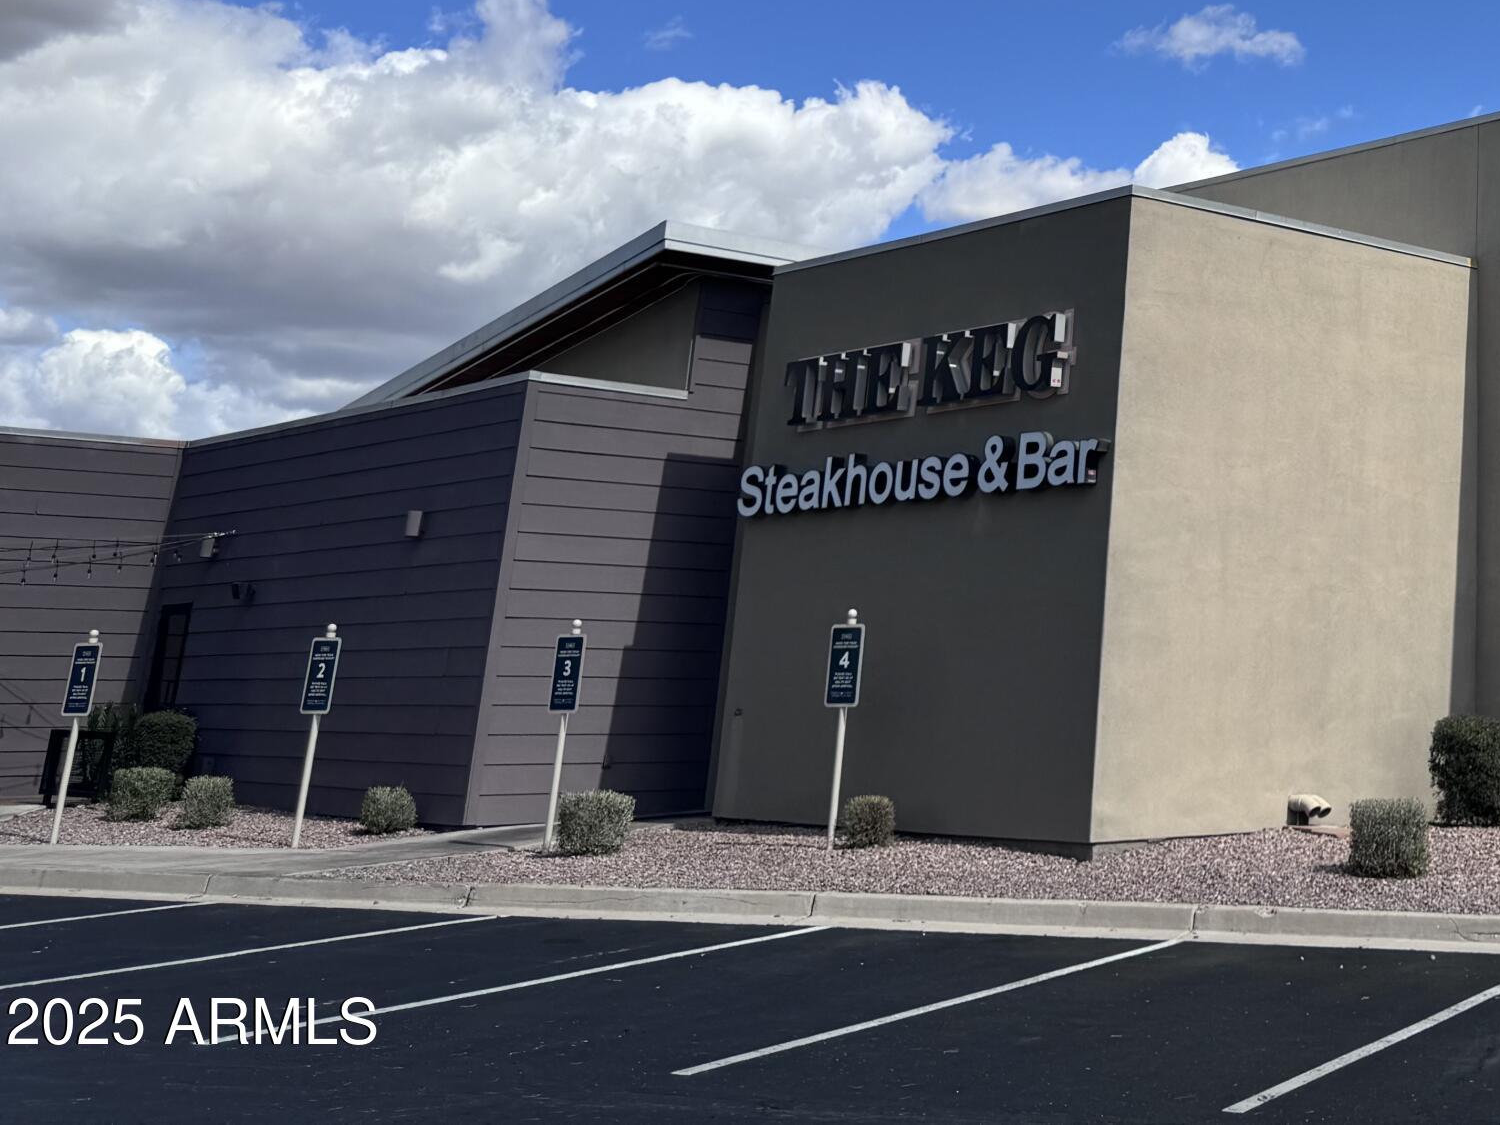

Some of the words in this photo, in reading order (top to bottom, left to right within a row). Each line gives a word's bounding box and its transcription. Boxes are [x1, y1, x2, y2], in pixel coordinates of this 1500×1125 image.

[784, 341, 912, 426] THE
[916, 313, 1069, 407] KEG
[737, 453, 970, 517] Steakhouse
[977, 434, 1009, 494] &
[1016, 431, 1099, 490] Bar
[562, 659, 572, 677] 3
[839, 650, 850, 669] 4
[80, 666, 87, 683] 1
[316, 662, 326, 679] 2
